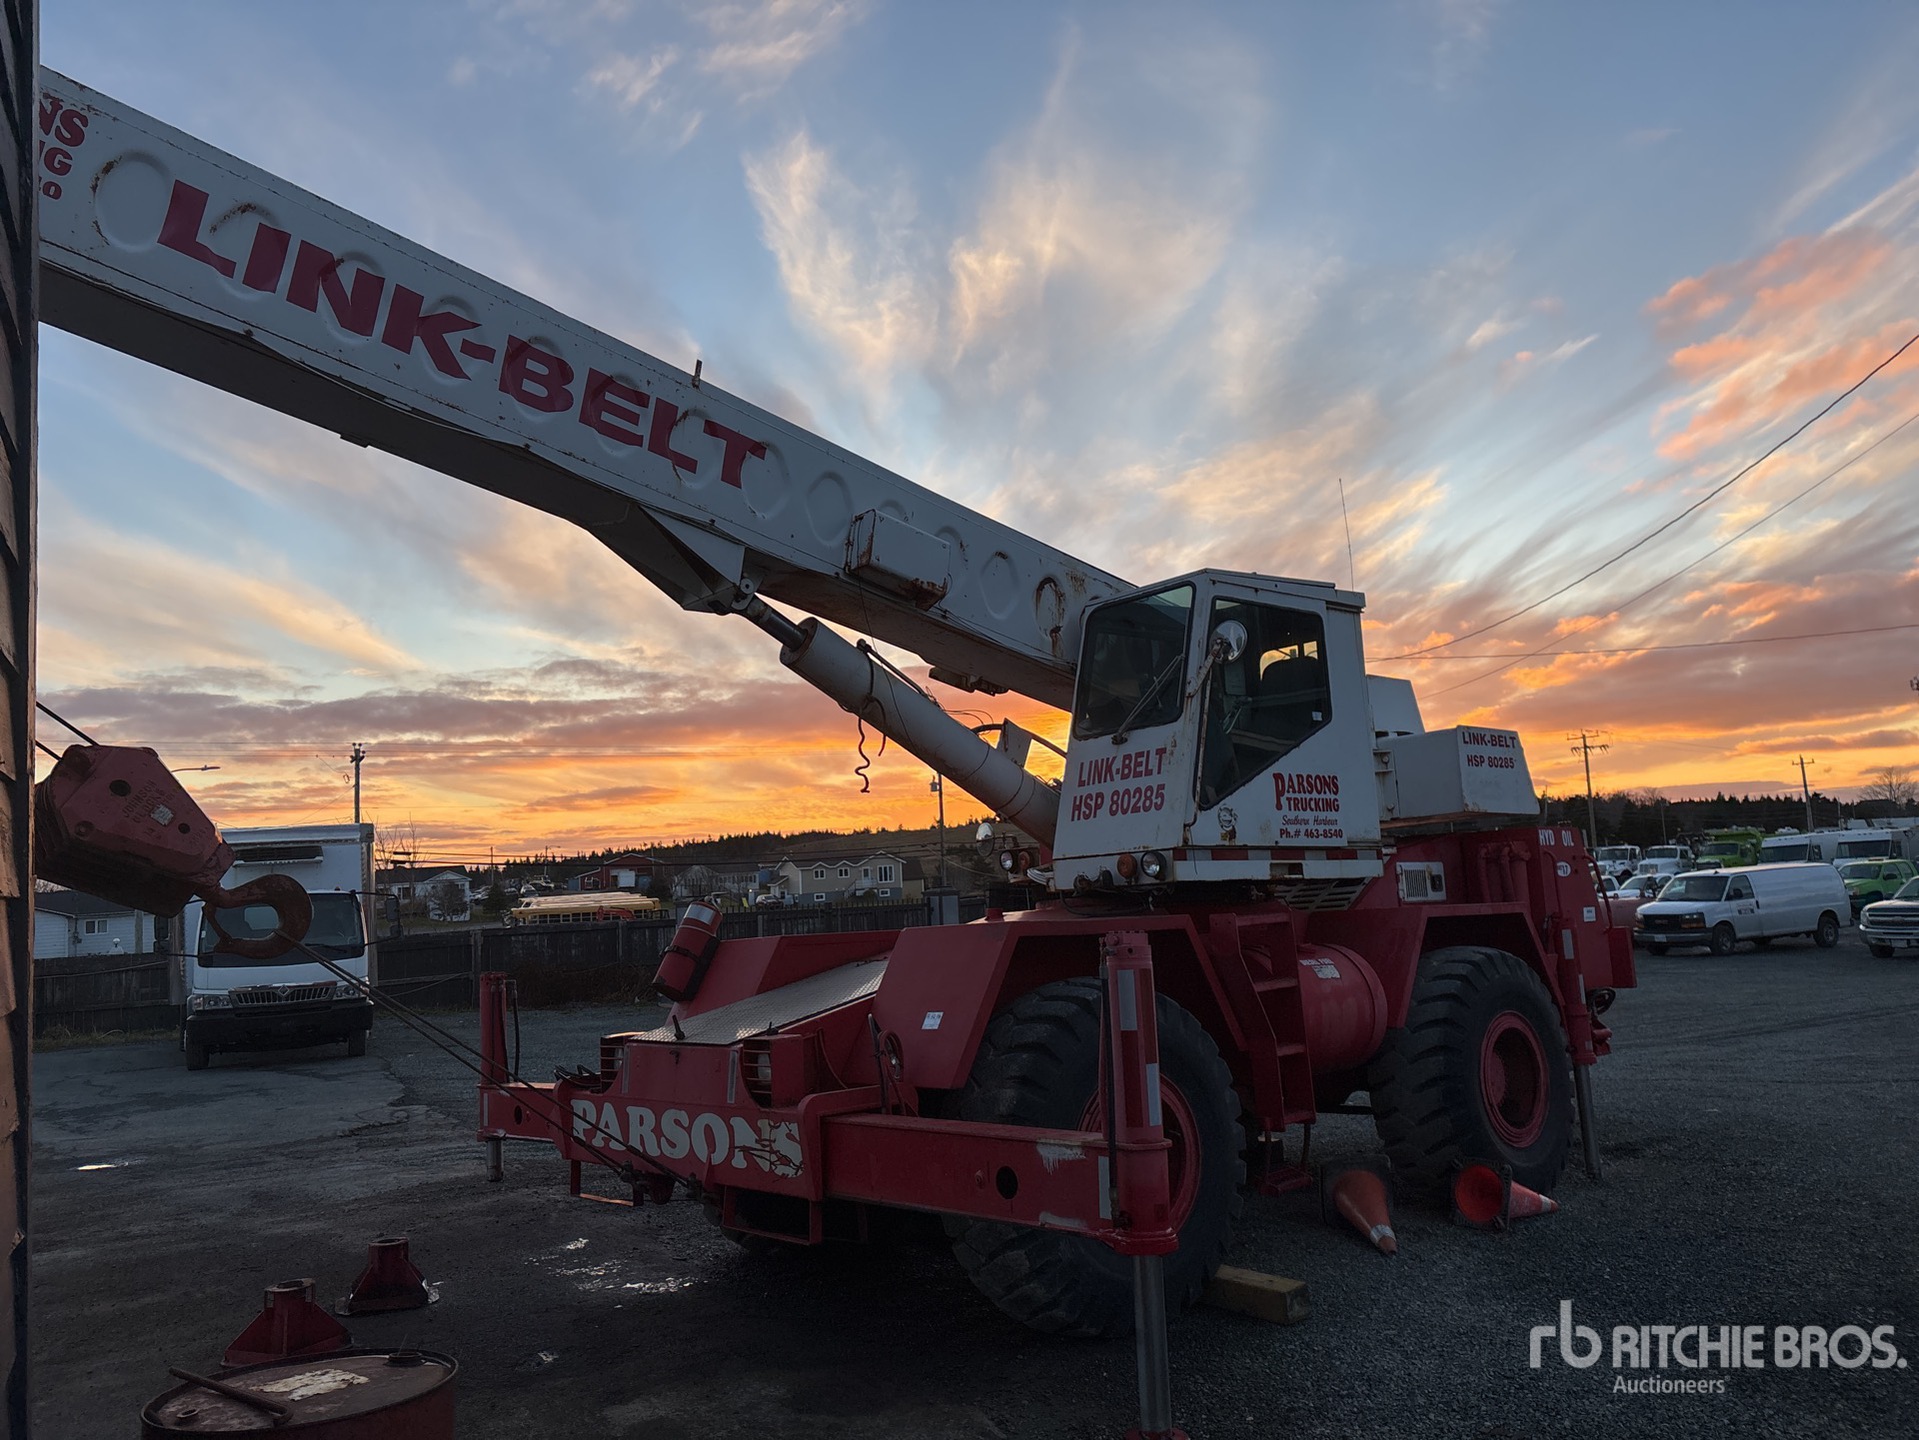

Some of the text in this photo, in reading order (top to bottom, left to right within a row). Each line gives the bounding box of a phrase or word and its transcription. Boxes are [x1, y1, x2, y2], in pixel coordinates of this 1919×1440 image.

[157, 179, 767, 489] LINK-BELT
[1462, 731, 1517, 749] LINK-BELT
[1077, 747, 1167, 787] LINK-BELT
[1467, 755, 1515, 769] HSP 80285
[1071, 783, 1166, 822] HSP 80285
[1273, 773, 1339, 811] PARSONS
[1286, 797, 1340, 812] TRUCKING
[1304, 828, 1343, 839] 463-8540
[1561, 830, 1575, 847] OIL
[570, 1099, 804, 1178] PARSONS
